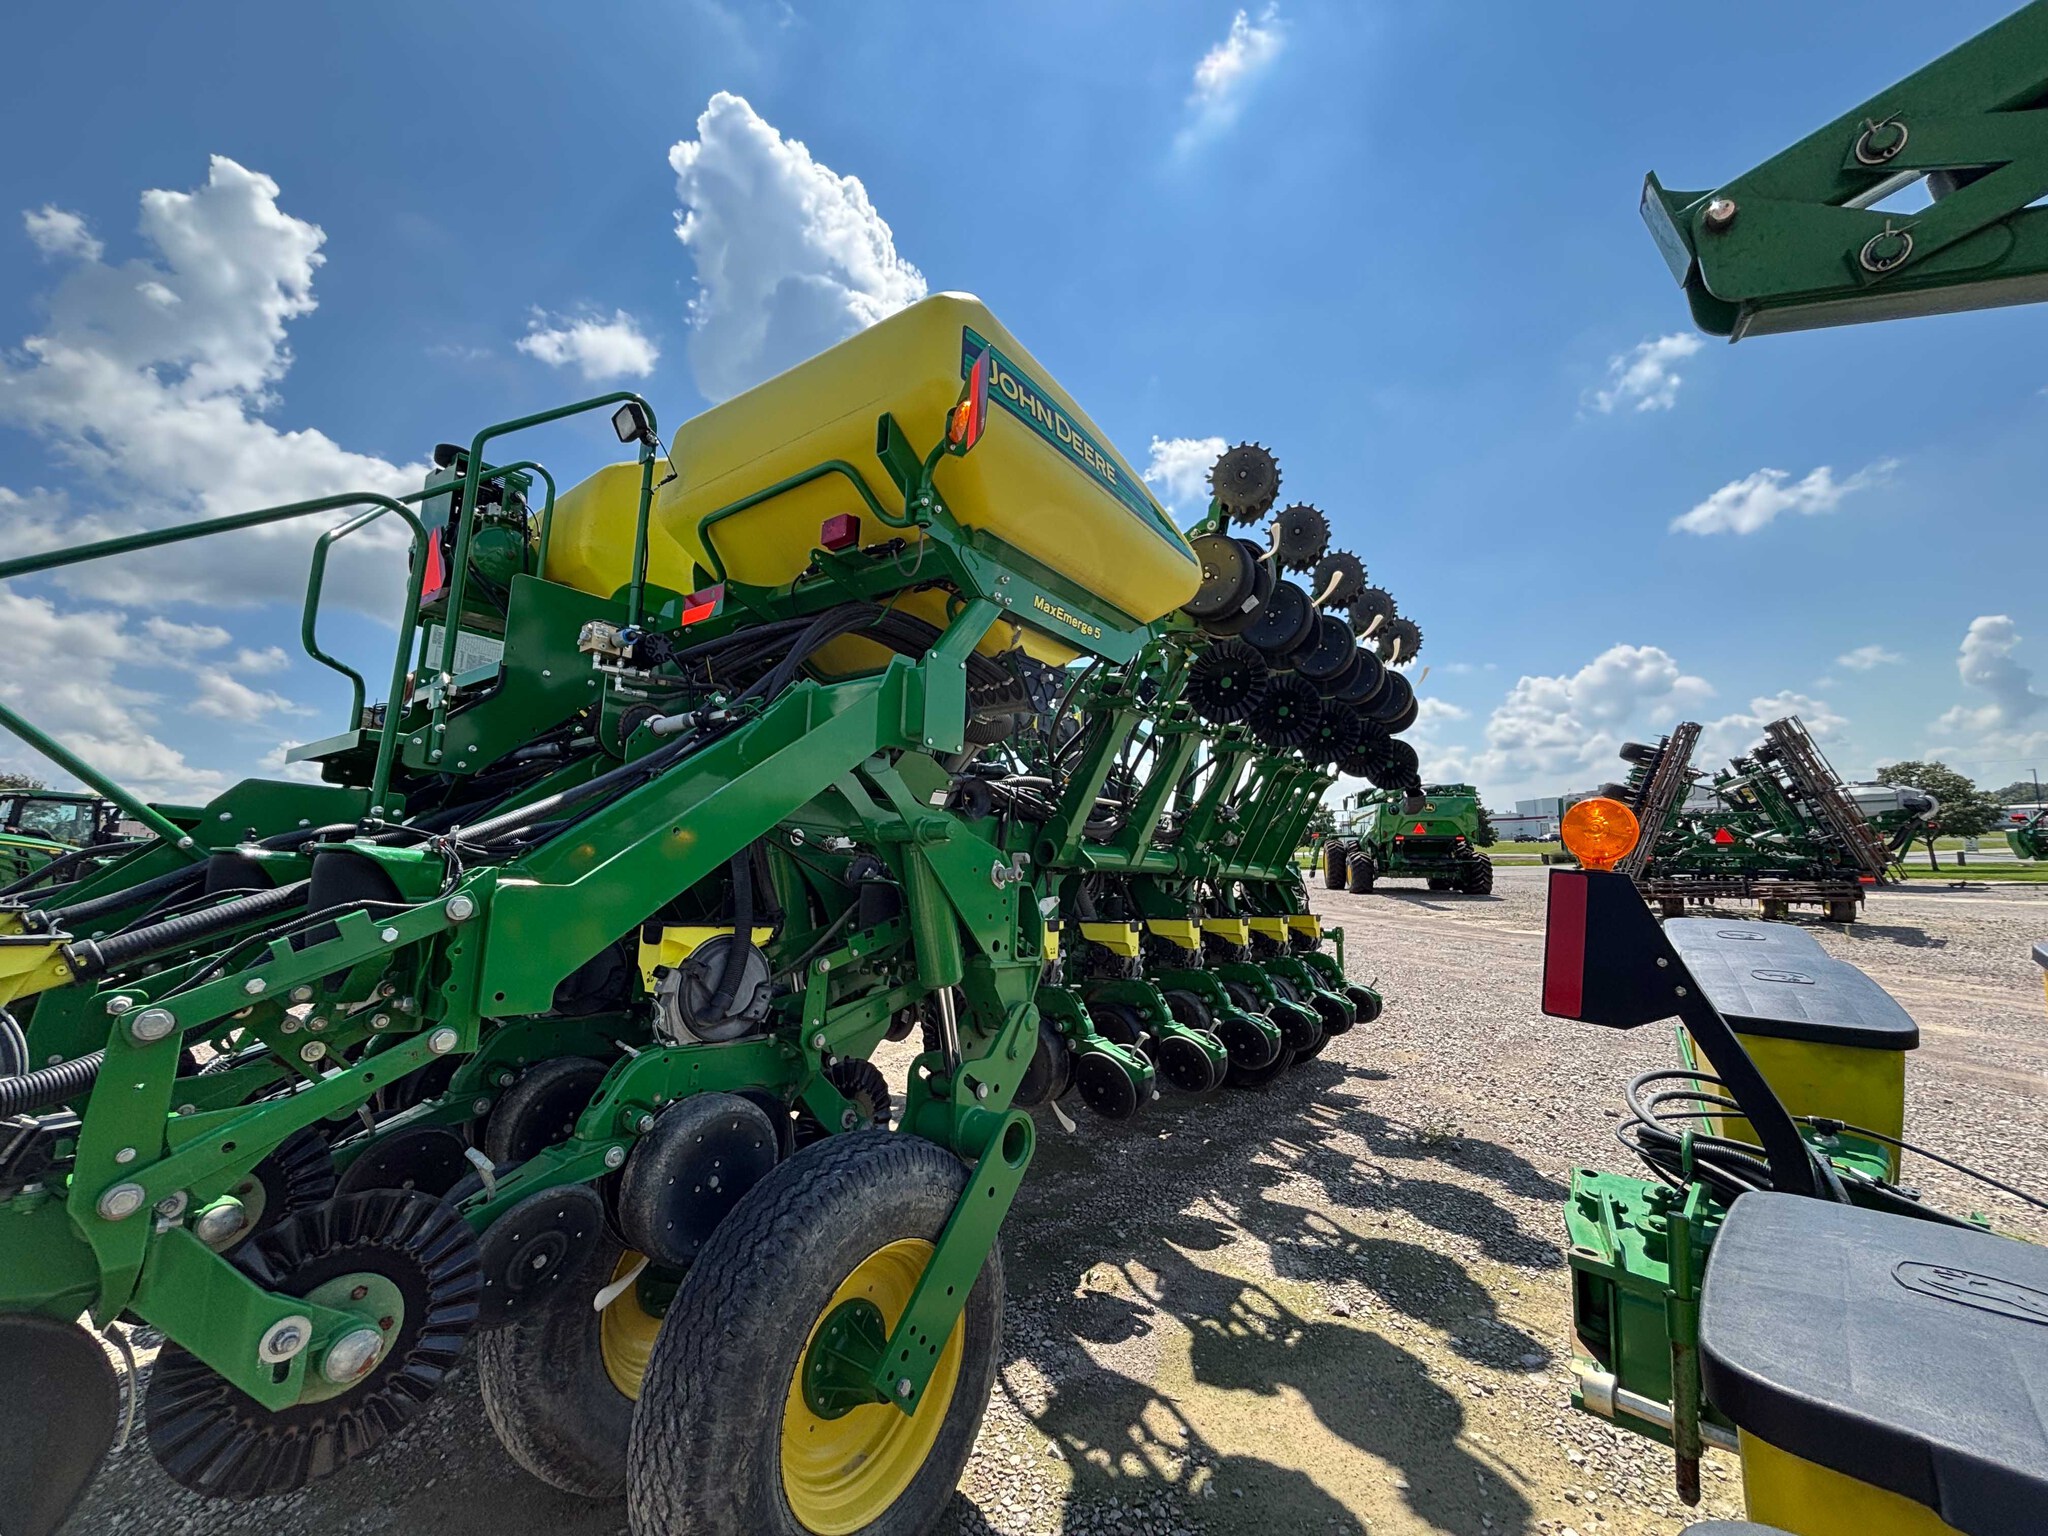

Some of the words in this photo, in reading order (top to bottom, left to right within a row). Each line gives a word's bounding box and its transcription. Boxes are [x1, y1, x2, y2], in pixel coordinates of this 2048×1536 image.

[988, 358, 1053, 431] JOHN
[1054, 411, 1117, 486] DEERE
[1033, 594, 1093, 635] MaxEmerge
[1094, 626, 1102, 639] 5
